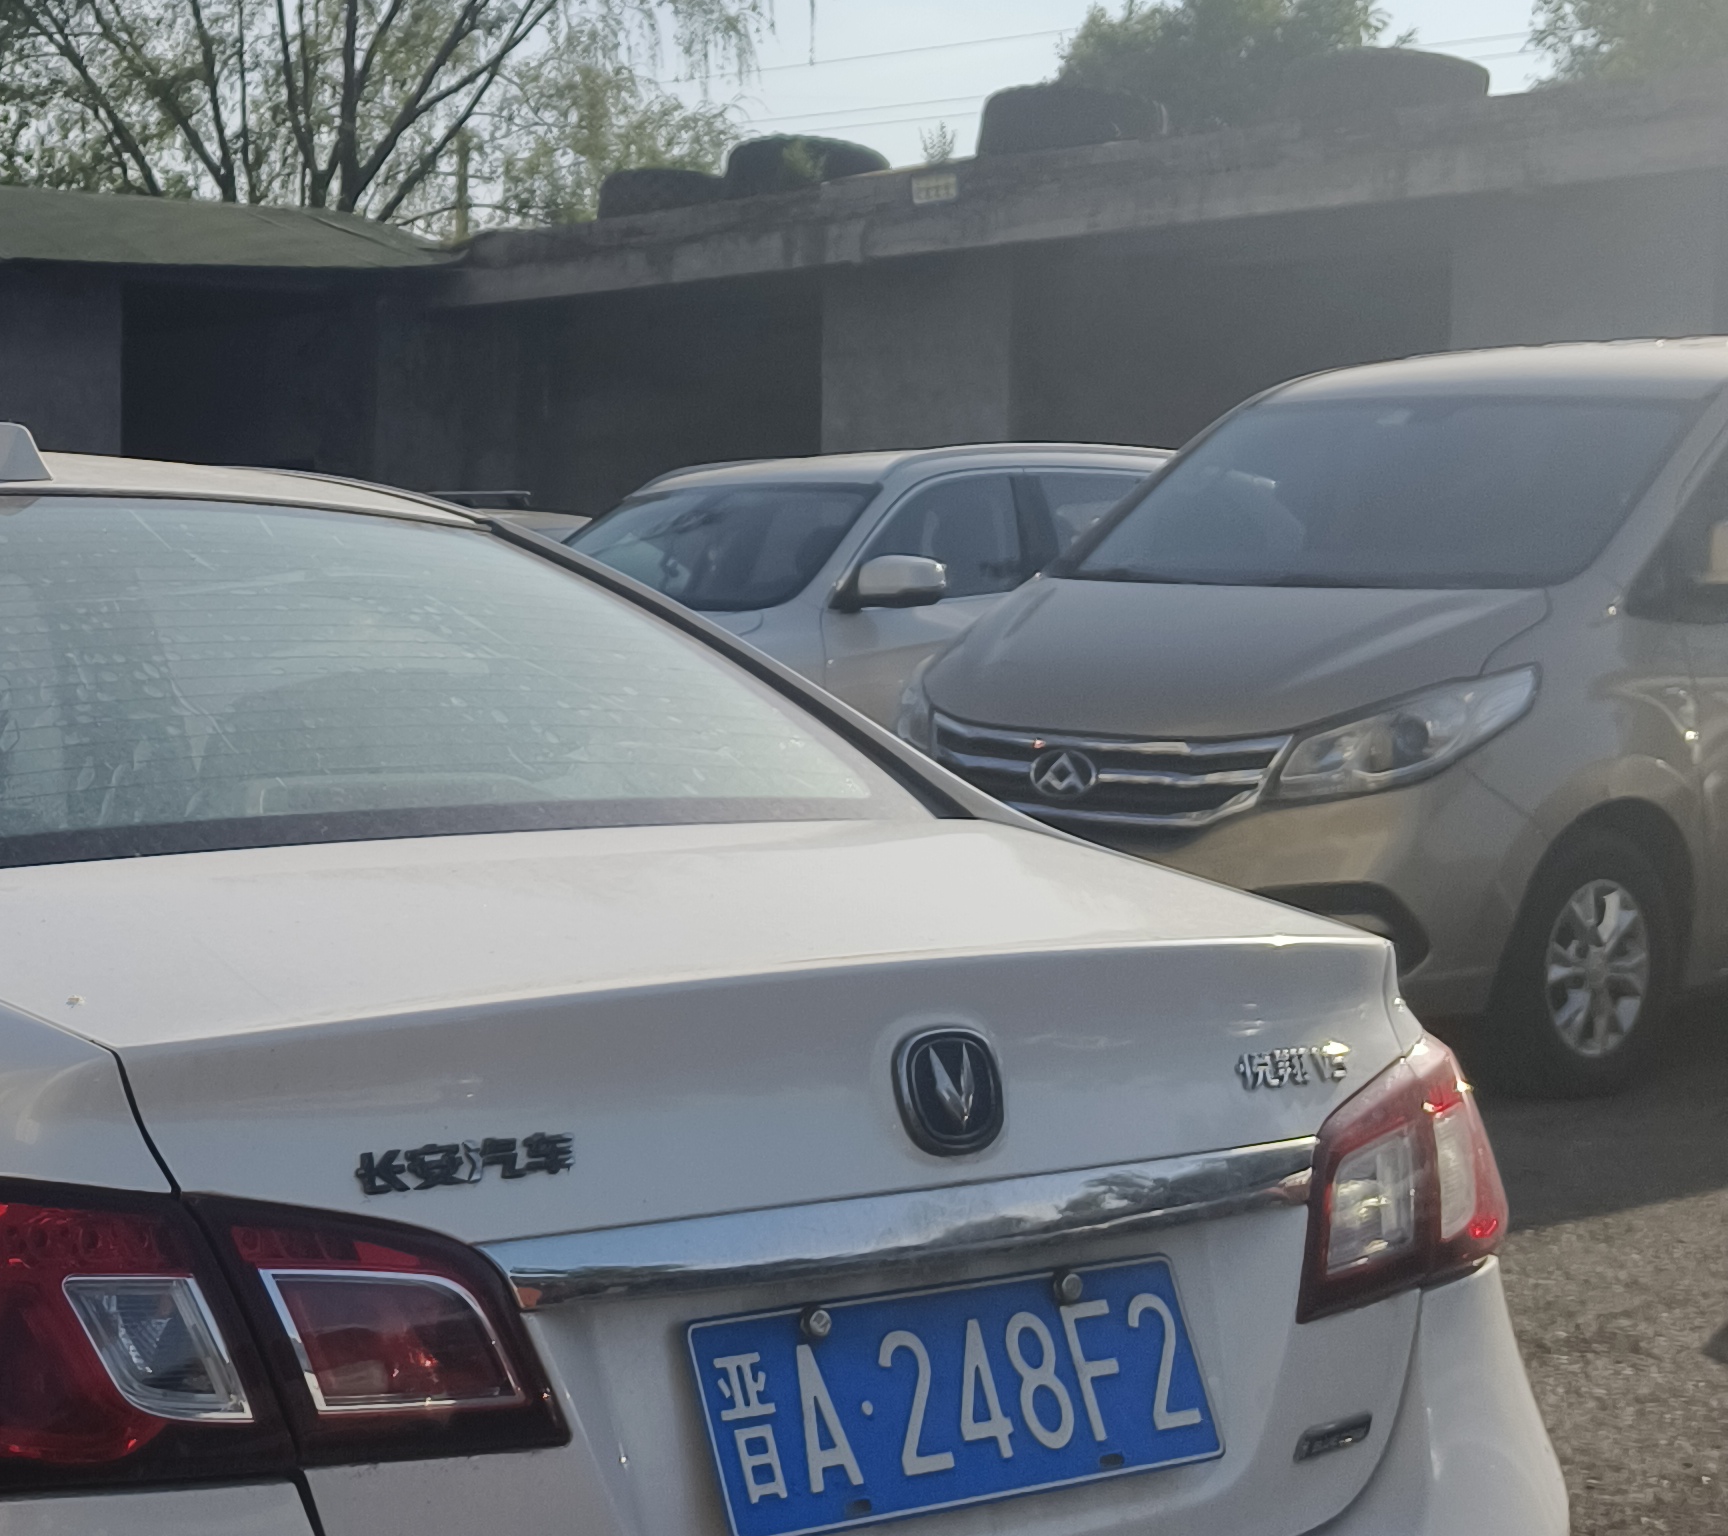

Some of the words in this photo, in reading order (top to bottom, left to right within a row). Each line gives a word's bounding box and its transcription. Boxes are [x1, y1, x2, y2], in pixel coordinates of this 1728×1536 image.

[355, 1131, 574, 1195] 长安汽车
[712, 1292, 1203, 1504] 晋A·248F2
